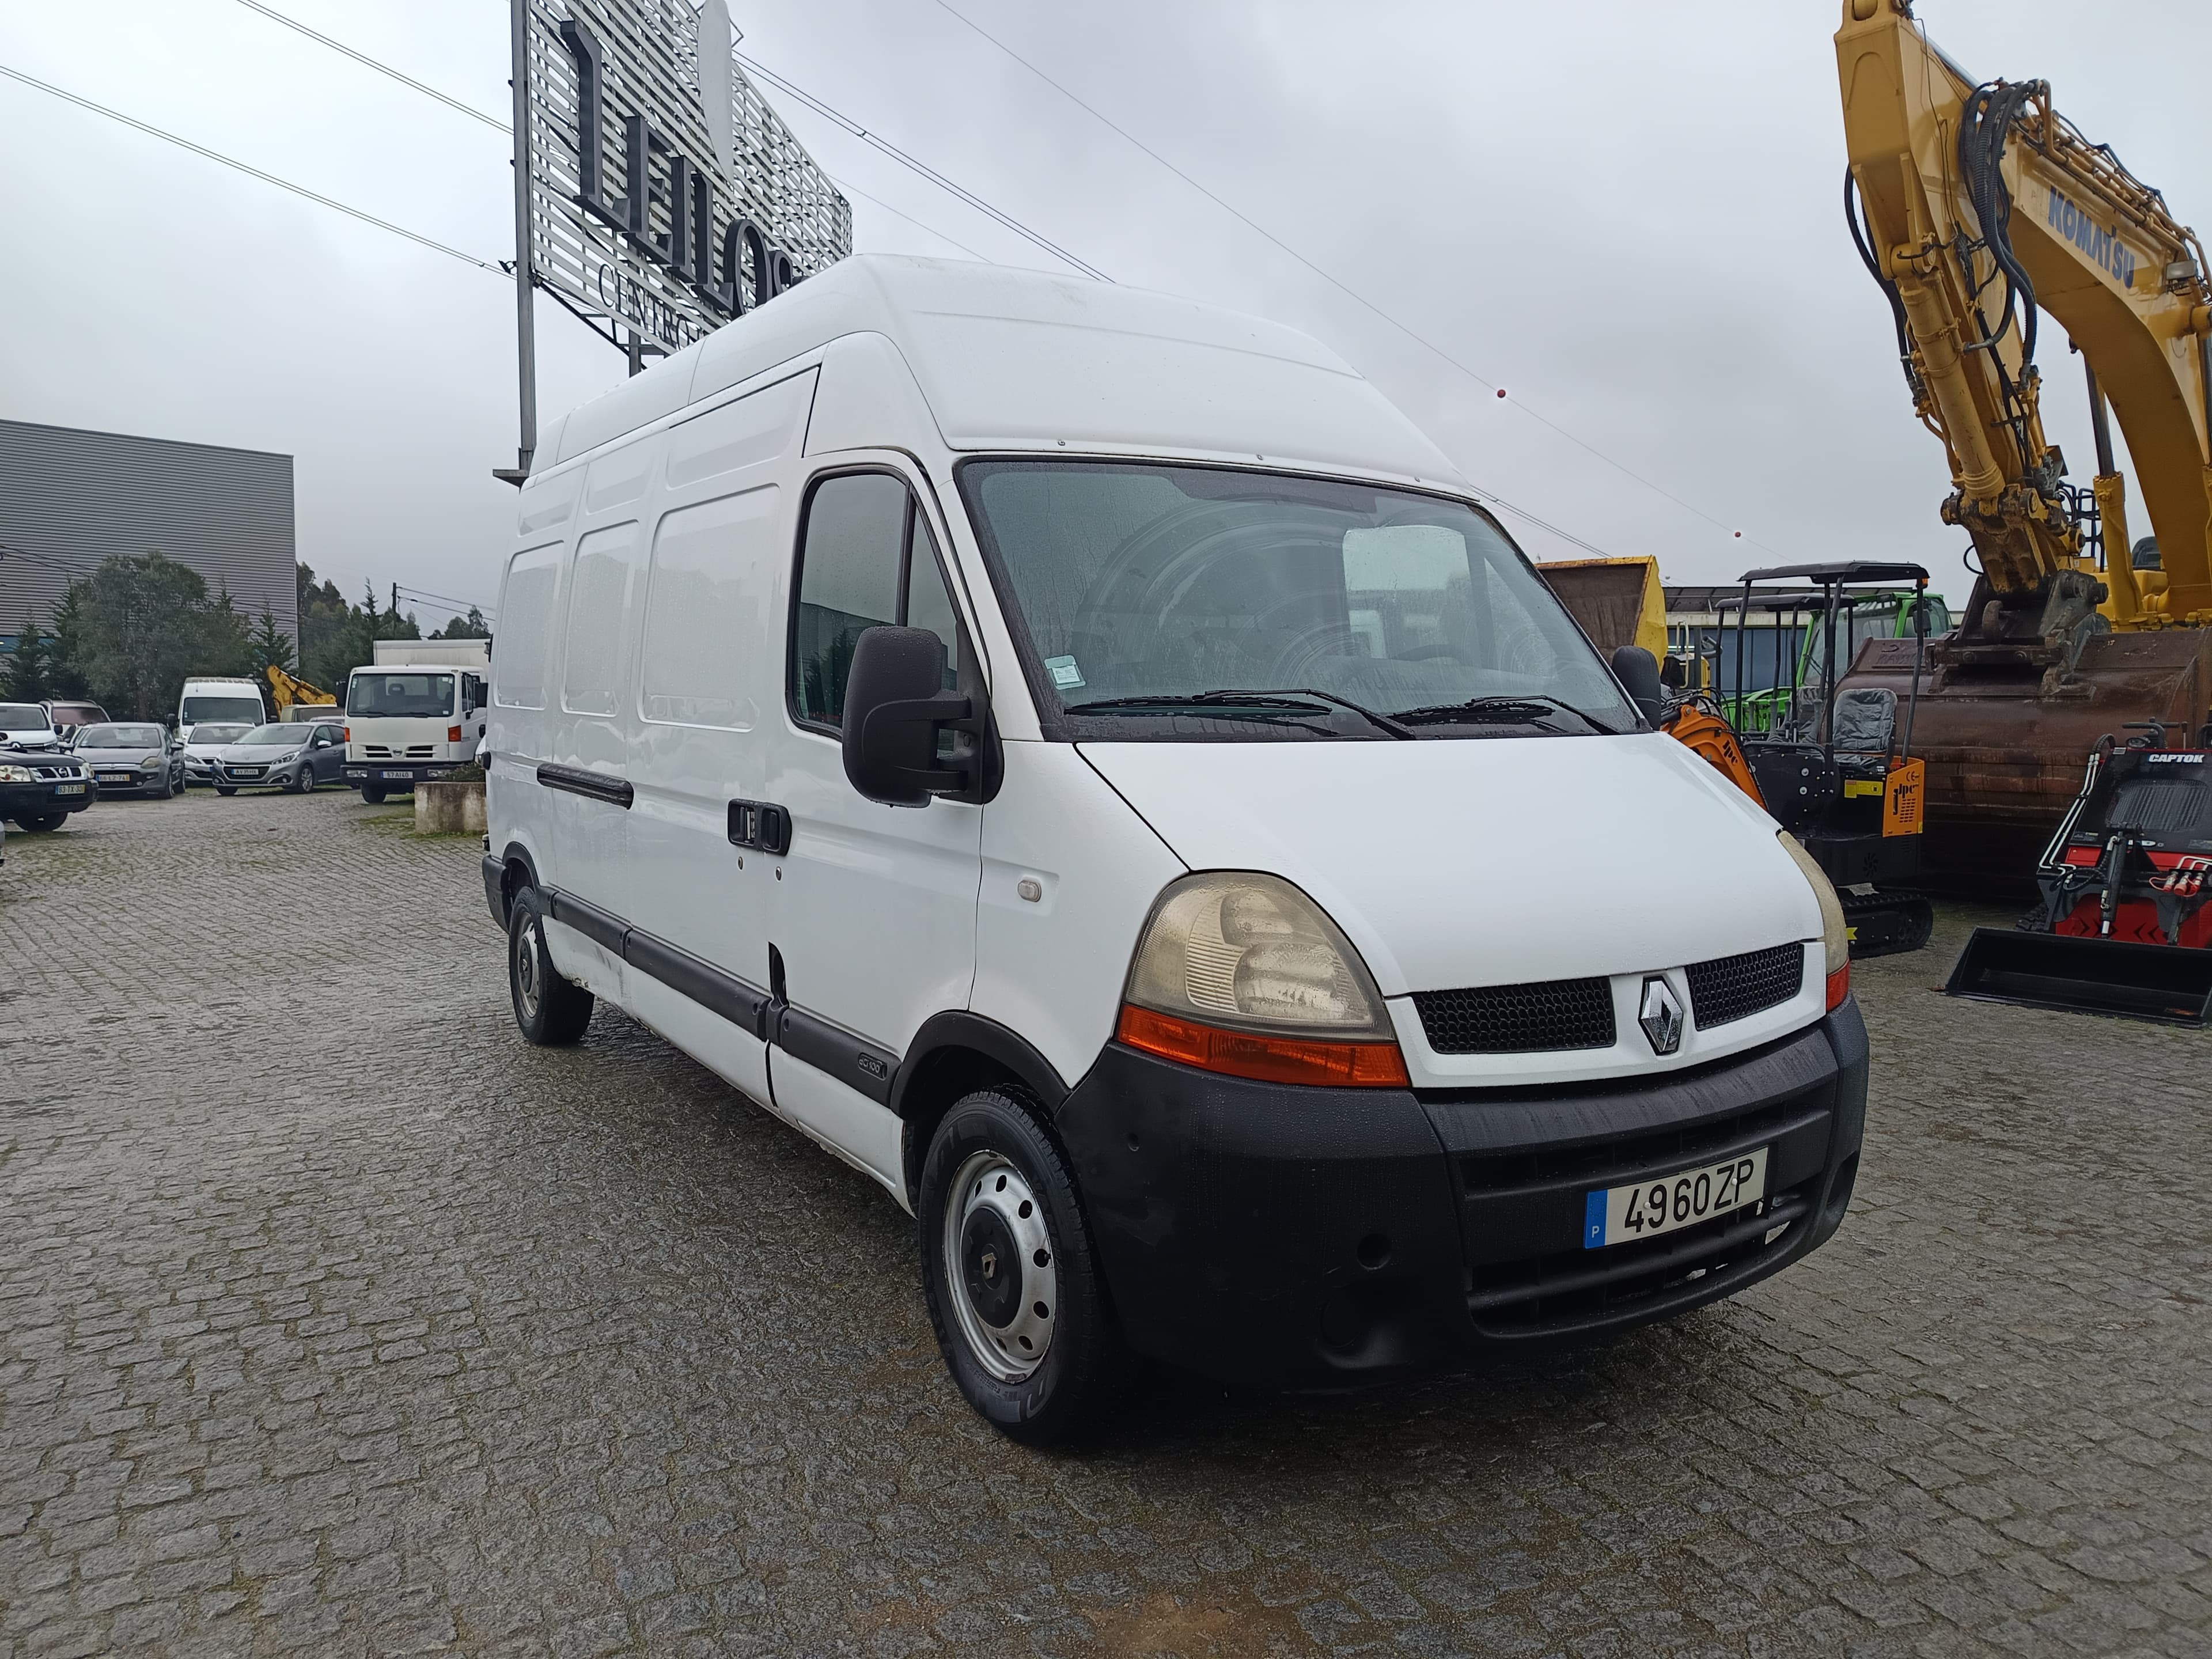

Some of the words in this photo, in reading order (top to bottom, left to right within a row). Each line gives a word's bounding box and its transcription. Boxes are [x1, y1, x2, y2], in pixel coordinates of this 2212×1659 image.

[2048, 185, 2135, 289] KOMATSU
[2149, 753, 2205, 763] CAPTOK
[1624, 1158, 1754, 1233] 4960ZP
[1592, 1225, 1600, 1238] P
